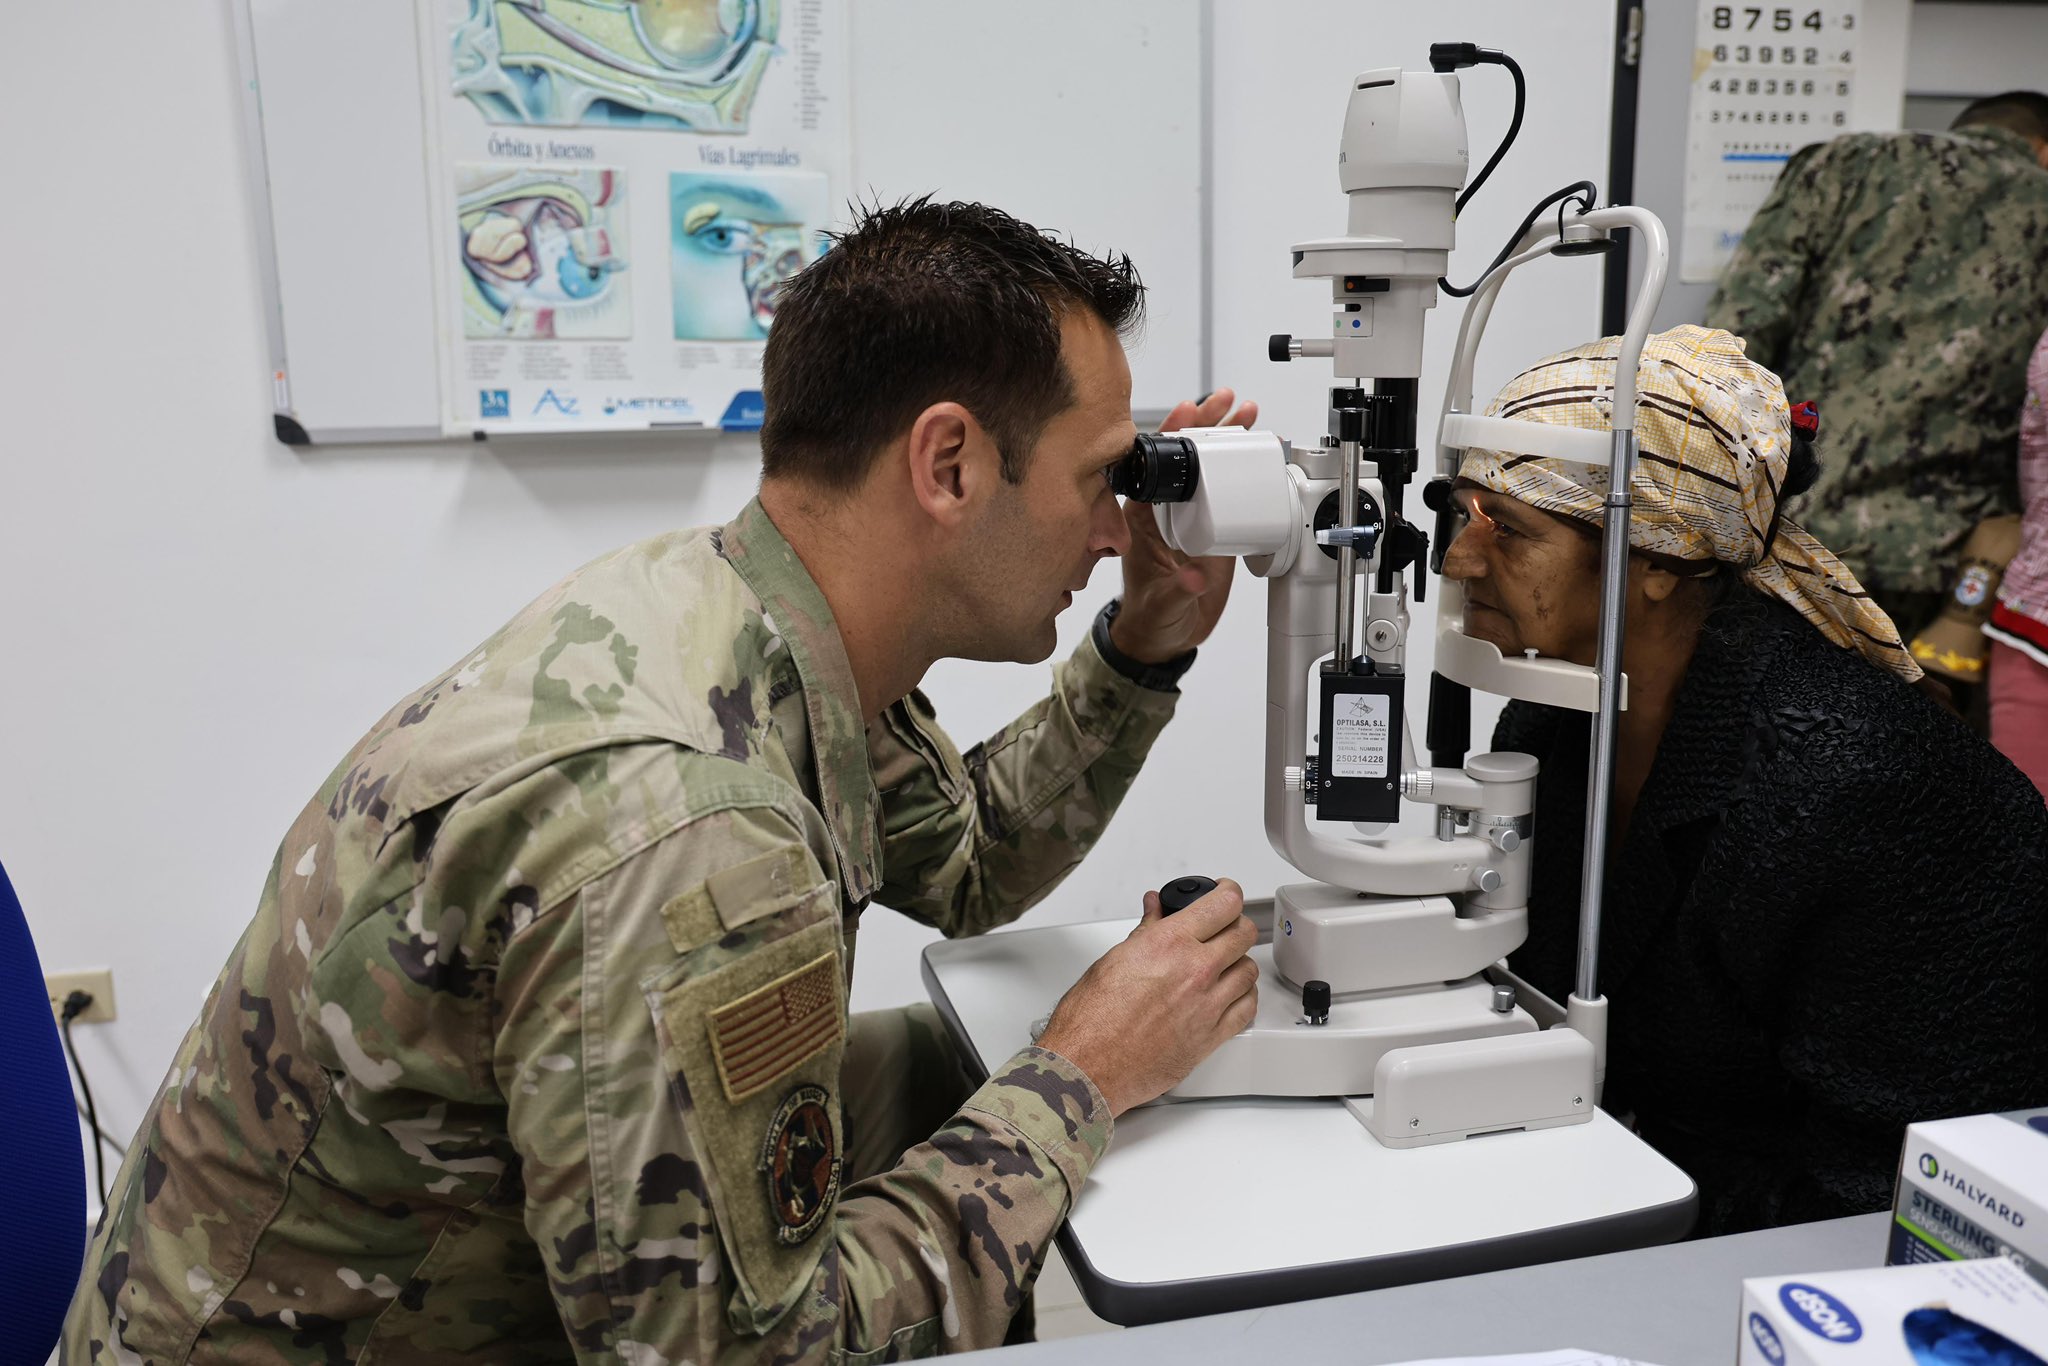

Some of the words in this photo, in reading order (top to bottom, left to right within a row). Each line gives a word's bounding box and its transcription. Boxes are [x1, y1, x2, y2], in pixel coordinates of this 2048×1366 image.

[729, 146, 800, 170] Lagrimales
[1336, 719, 1371, 728] OPTILASA,
[1373, 719, 1386, 727] S.L.
[1336, 754, 1384, 764] 250214228
[1942, 1169, 2025, 1228] HALYARD
[1912, 1190, 1996, 1256] STERLING
